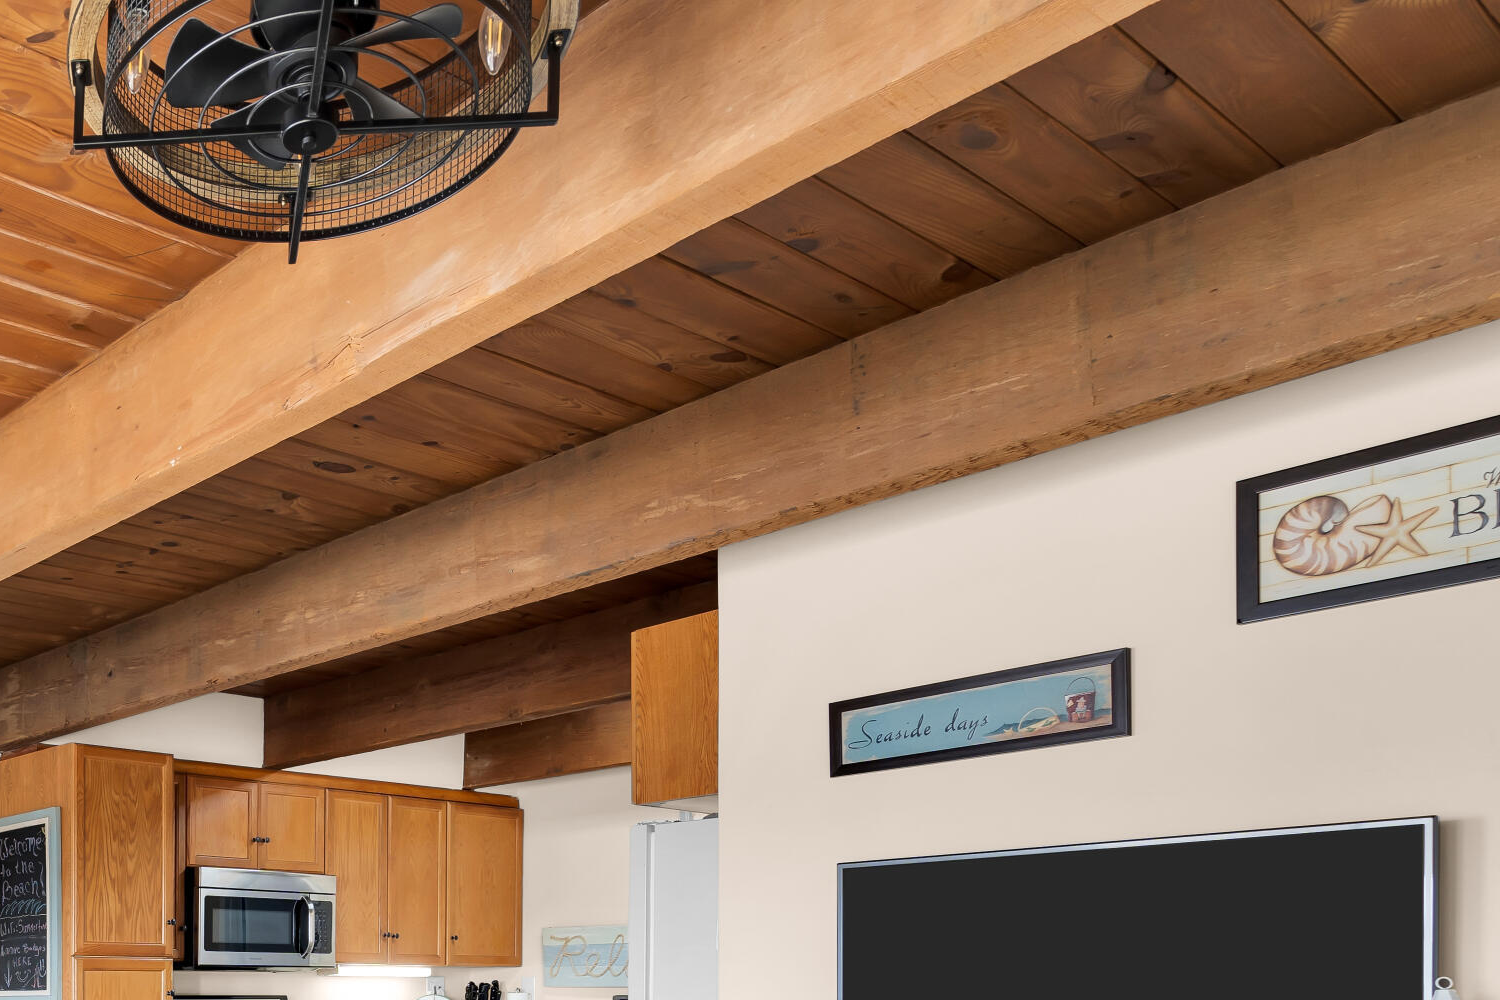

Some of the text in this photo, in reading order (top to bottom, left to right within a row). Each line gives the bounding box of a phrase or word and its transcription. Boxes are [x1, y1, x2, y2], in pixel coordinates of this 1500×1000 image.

[848, 708, 989, 750] Seaside days
[0, 836, 43, 861] Welcome
[0, 859, 36, 878] to the
